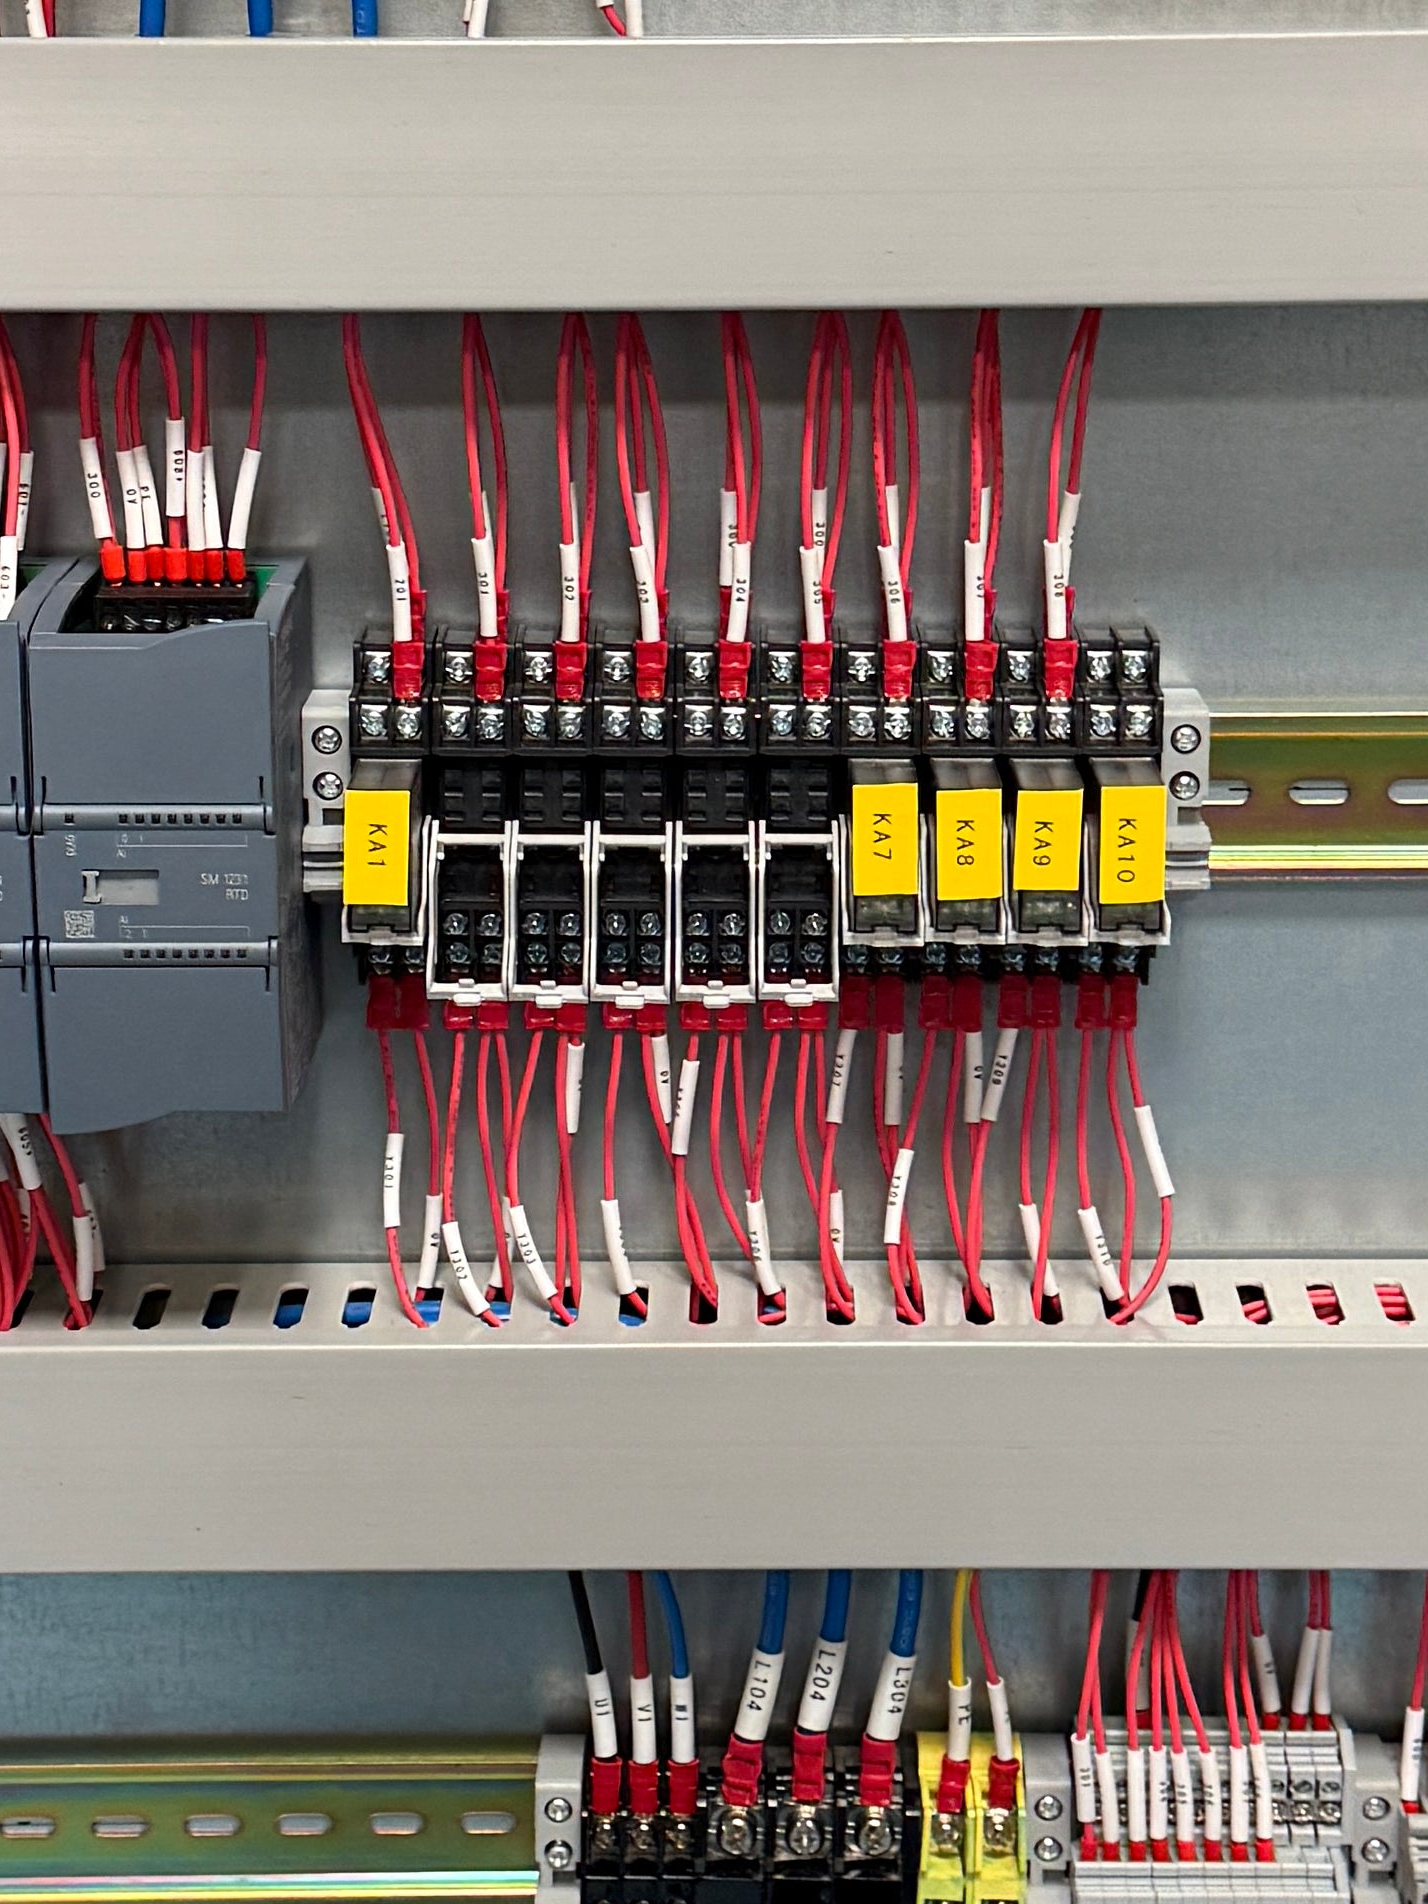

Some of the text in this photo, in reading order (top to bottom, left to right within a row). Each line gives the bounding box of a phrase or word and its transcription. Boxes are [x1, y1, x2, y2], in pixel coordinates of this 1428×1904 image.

[87, 472, 100, 498] 300
[736, 577, 748, 604] 304
[367, 823, 388, 867] KA1
[871, 812, 892, 862] KA7
[955, 819, 976, 867] KA8
[1032, 819, 1054, 867] KA9
[1116, 817, 1138, 884] KA10
[199, 873, 219, 886] SM
[225, 888, 249, 901] RTD
[746, 1660, 773, 1714] L104
[809, 1648, 837, 1703] L204
[886, 1664, 913, 1716] L304
[593, 1697, 610, 1717] U1
[636, 1702, 653, 1723] V1
